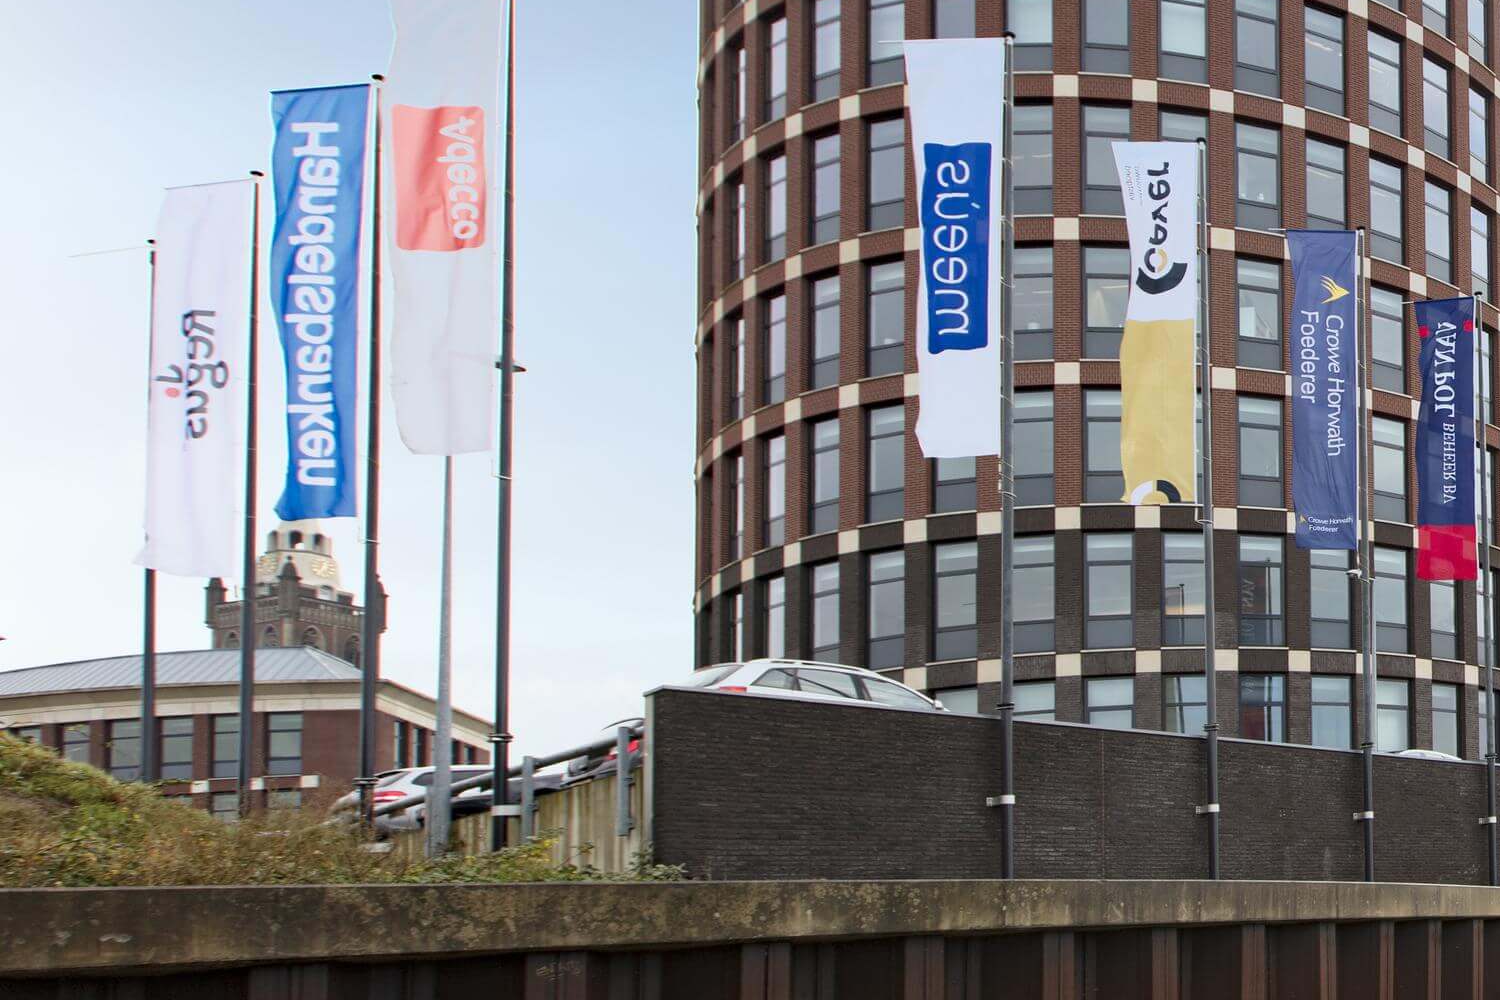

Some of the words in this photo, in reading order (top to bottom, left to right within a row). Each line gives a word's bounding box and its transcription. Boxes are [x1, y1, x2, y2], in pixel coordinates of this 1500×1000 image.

[1300, 310, 1320, 404] Foederer
[1326, 315, 1344, 373] Crowe
[1327, 378, 1346, 456] Horwath
[1308, 516, 1329, 525] Crowe
[1329, 516, 1354, 525] Horwath
[1308, 524, 1338, 533] Foederer
